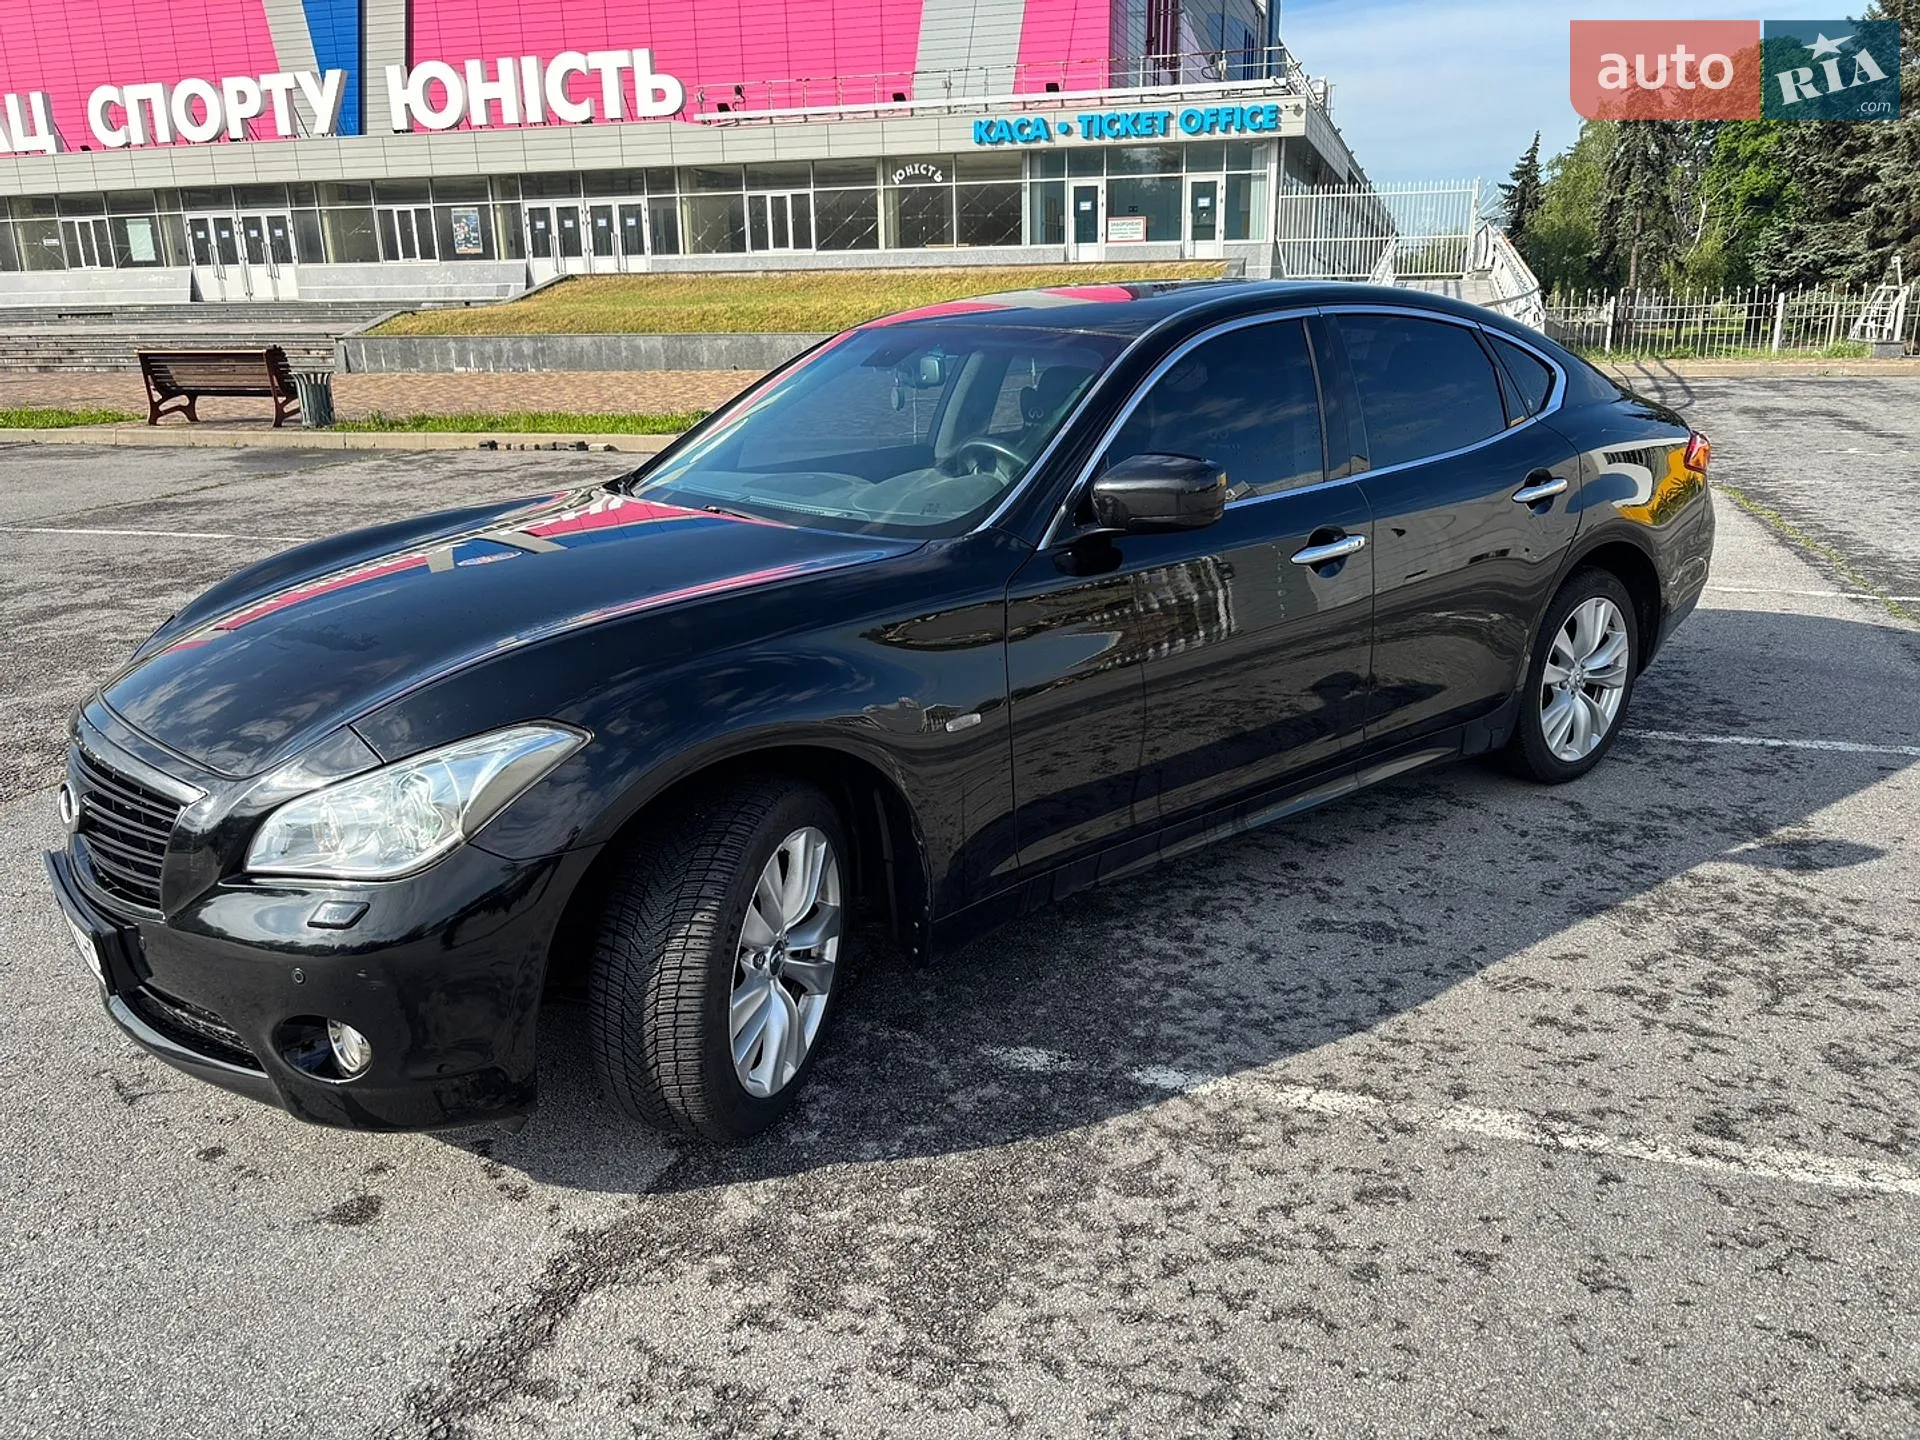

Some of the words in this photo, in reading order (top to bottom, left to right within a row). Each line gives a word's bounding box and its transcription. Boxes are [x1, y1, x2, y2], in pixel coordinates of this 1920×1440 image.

[0, 91, 58, 154] Ц
[87, 69, 346, 148] СПОРТУ
[385, 48, 686, 131] ЮНІСТЬ
[973, 116, 1052, 145] КАСА
[1077, 110, 1171, 140] TICKET
[1179, 104, 1281, 134] OFFICE
[891, 163, 943, 185] ЮНІСТЬ
